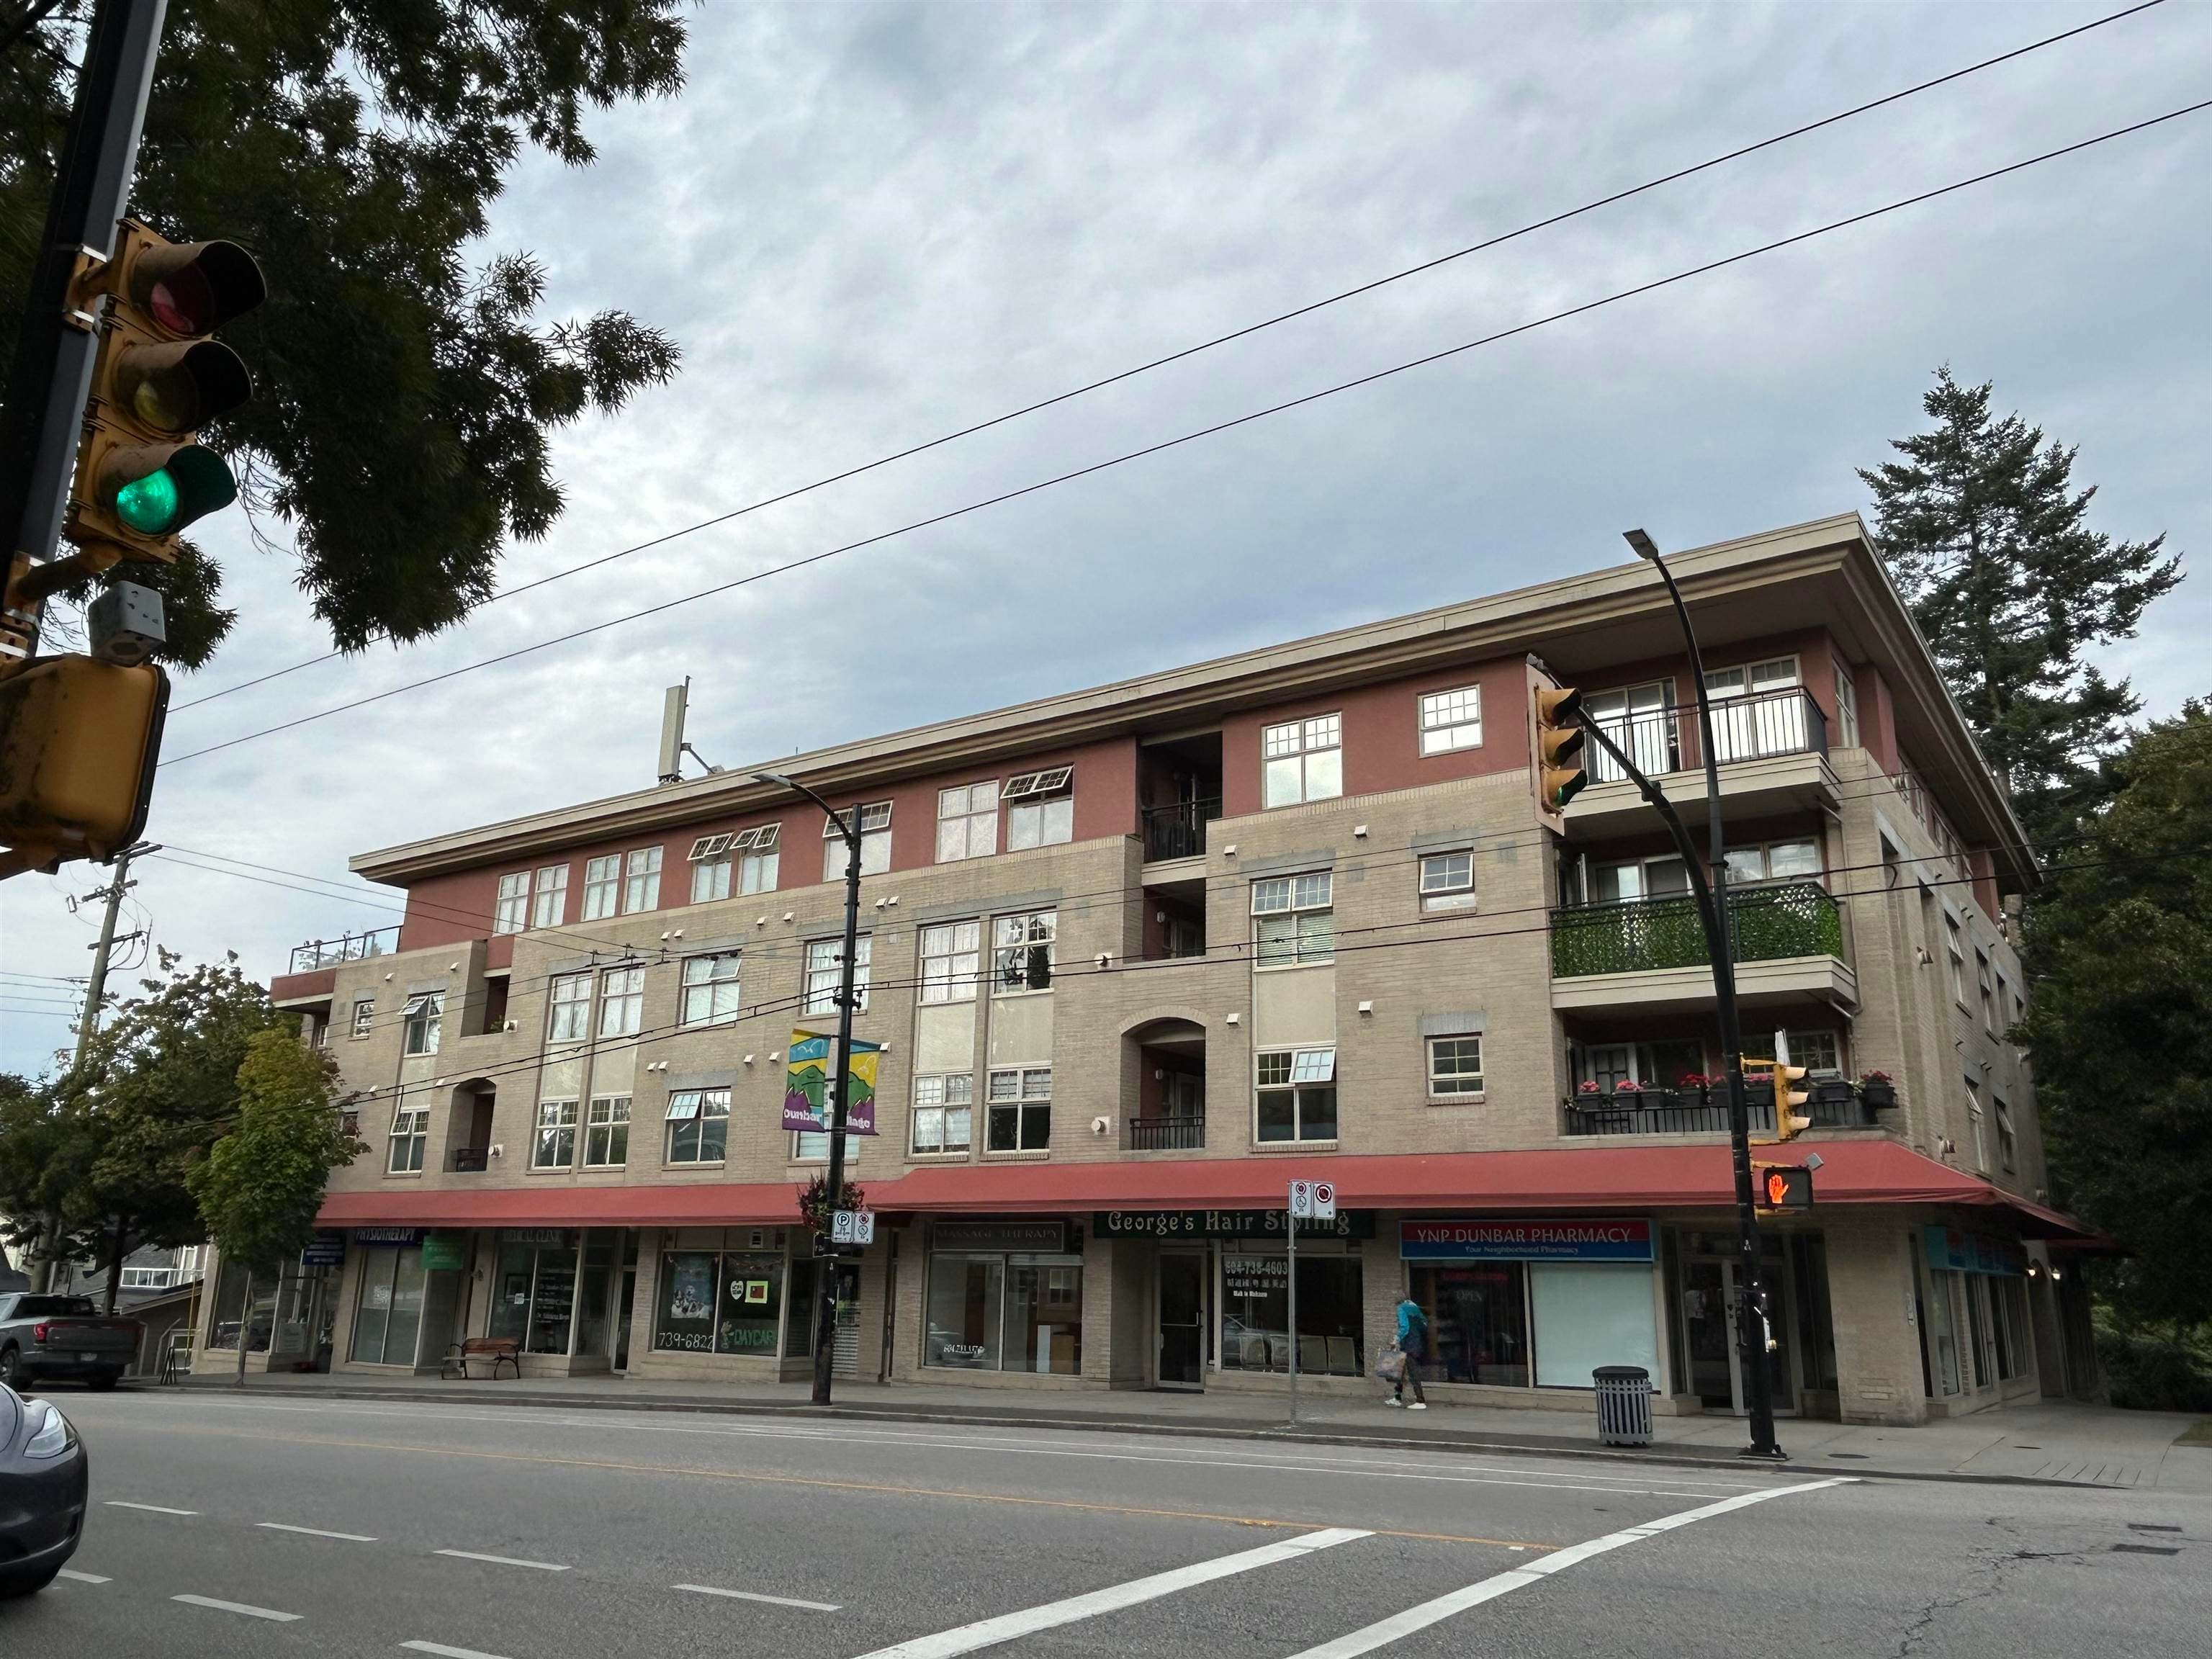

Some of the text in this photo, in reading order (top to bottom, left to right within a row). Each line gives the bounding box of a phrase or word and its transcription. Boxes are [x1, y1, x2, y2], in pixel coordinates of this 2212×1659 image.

[783, 1108, 822, 1122] Dunbar
[1107, 1211, 1195, 1236] George's
[1205, 1211, 1254, 1231] Hair
[1417, 1228, 1632, 1244] YNP DUNBAR PHARMACY
[1541, 1246, 1578, 1255] Pharmacy
[658, 1332, 714, 1349] 739-6822
